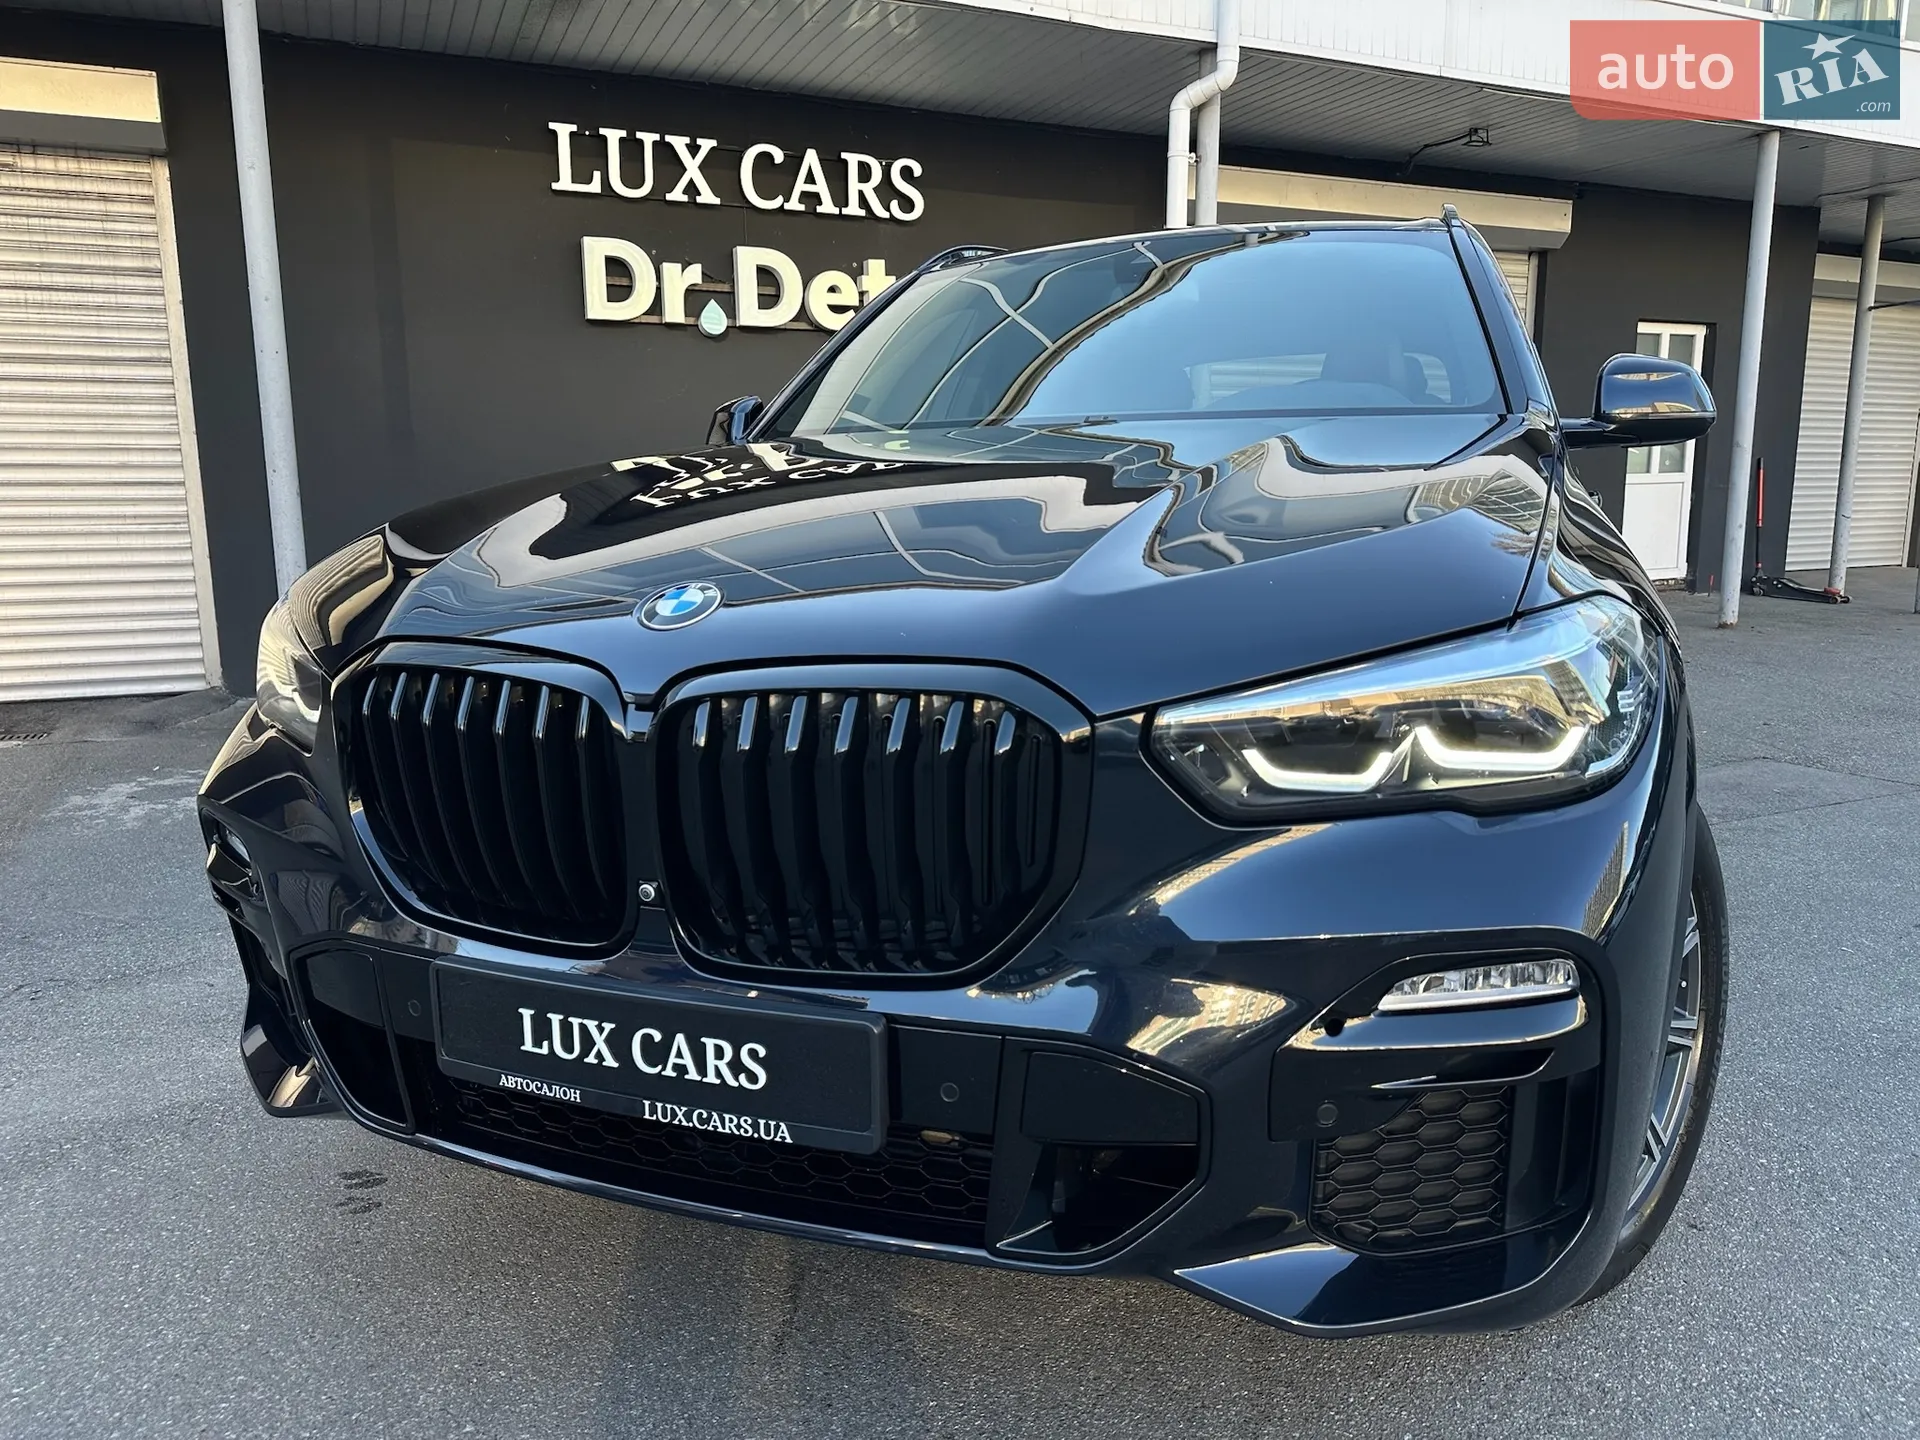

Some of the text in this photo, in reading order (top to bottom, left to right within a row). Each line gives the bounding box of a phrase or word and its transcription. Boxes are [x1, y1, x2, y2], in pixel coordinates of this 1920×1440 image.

[547, 121, 925, 222] LUX CARS
[517, 1007, 768, 1090] LUX CARS
[499, 1074, 581, 1103] АВТОСАЛОН
[643, 1100, 794, 1144] LUX.CARS.UA
